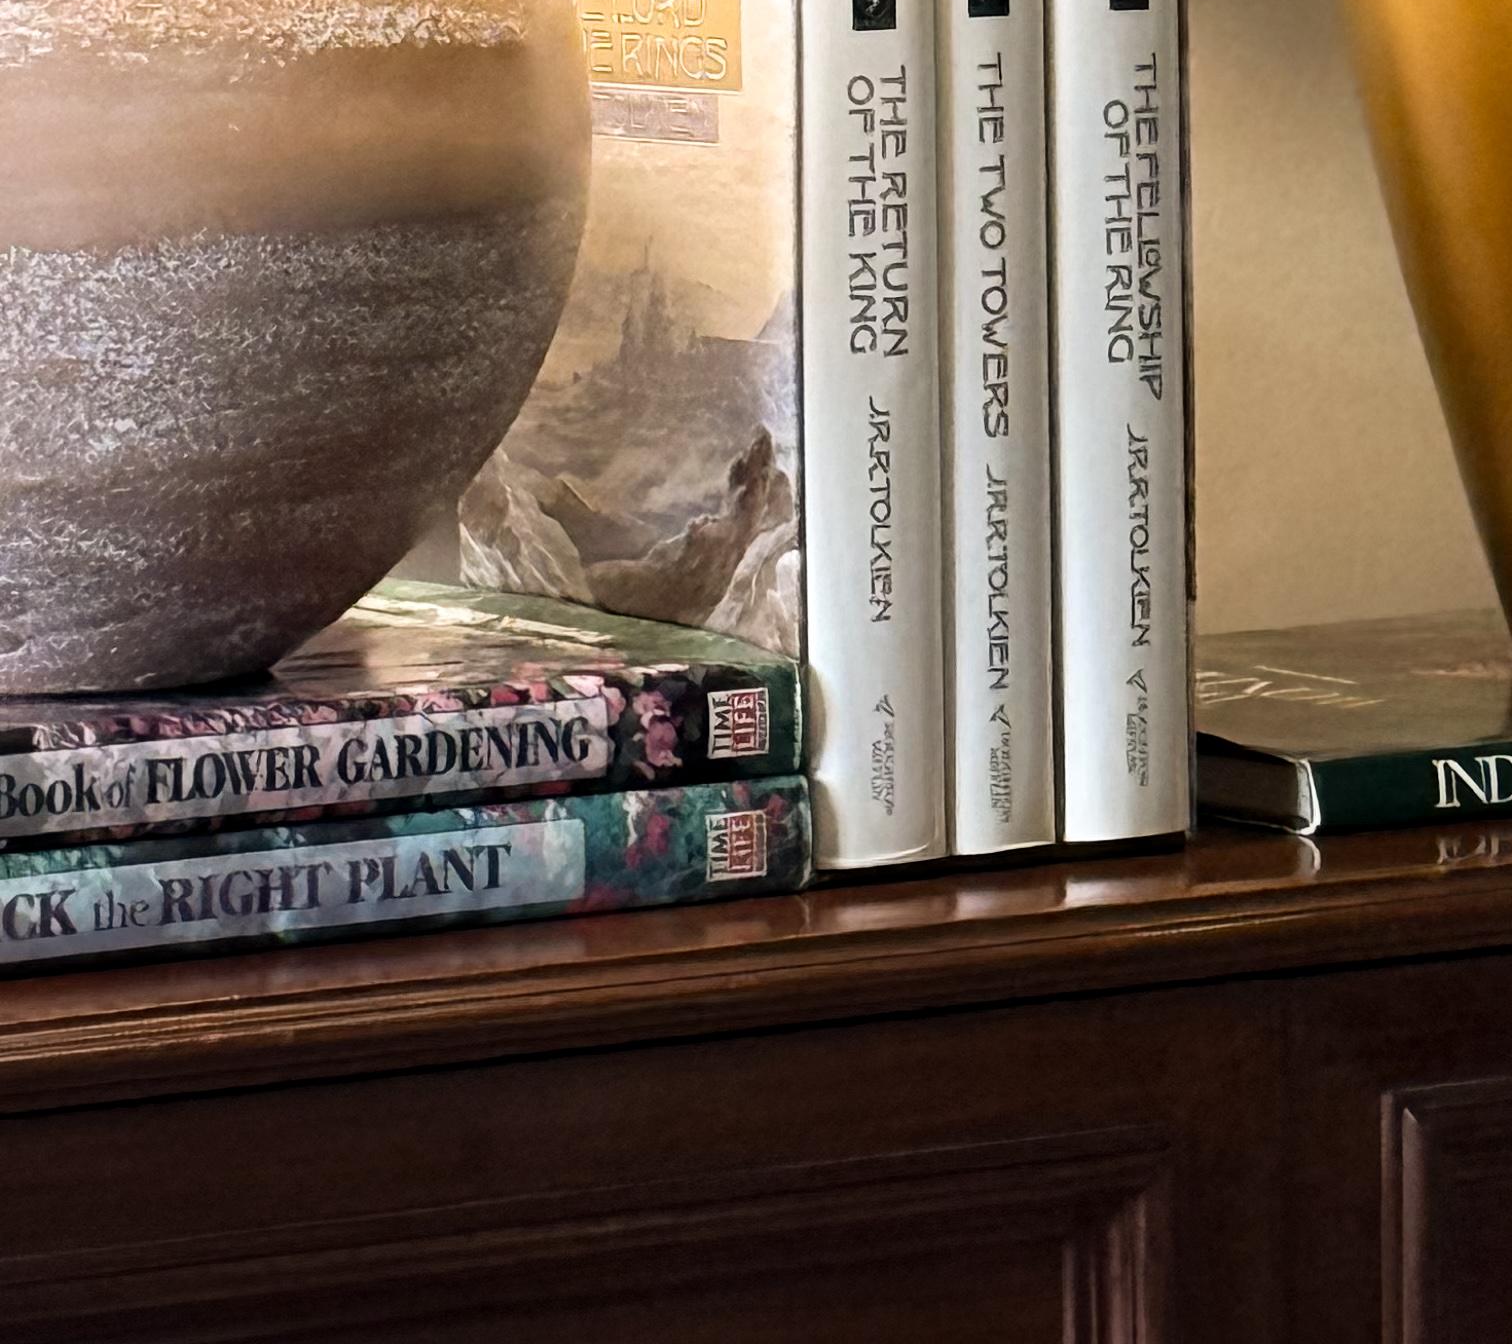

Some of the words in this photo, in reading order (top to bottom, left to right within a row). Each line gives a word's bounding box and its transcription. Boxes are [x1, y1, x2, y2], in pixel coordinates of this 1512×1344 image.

[620, 32, 728, 80] RINGS
[976, 51, 1004, 144] THE
[1134, 52, 1159, 146] THE
[847, 74, 875, 136] OF
[880, 64, 907, 160] THE
[1102, 99, 1131, 159] OF
[848, 142, 877, 237] THE
[979, 154, 1006, 250] TWO
[1104, 163, 1133, 256] THE
[848, 252, 877, 354] KING
[879, 172, 910, 358] RETURN
[1136, 152, 1163, 402] FELLOWSHIP
[981, 257, 1009, 439] TOWERS
[1104, 265, 1135, 364] RING
[0, 763, 101, 820] Book
[105, 762, 140, 809] of
[145, 743, 323, 805] FLOWER
[337, 715, 590, 785] GARDENING
[712, 695, 733, 755] TIME
[734, 693, 756, 752] LIFE
[0, 889, 77, 942] CK
[94, 889, 150, 931] the
[158, 861, 333, 925] RIGHT
[346, 841, 512, 904] PLANT
[710, 815, 729, 879] TIME
